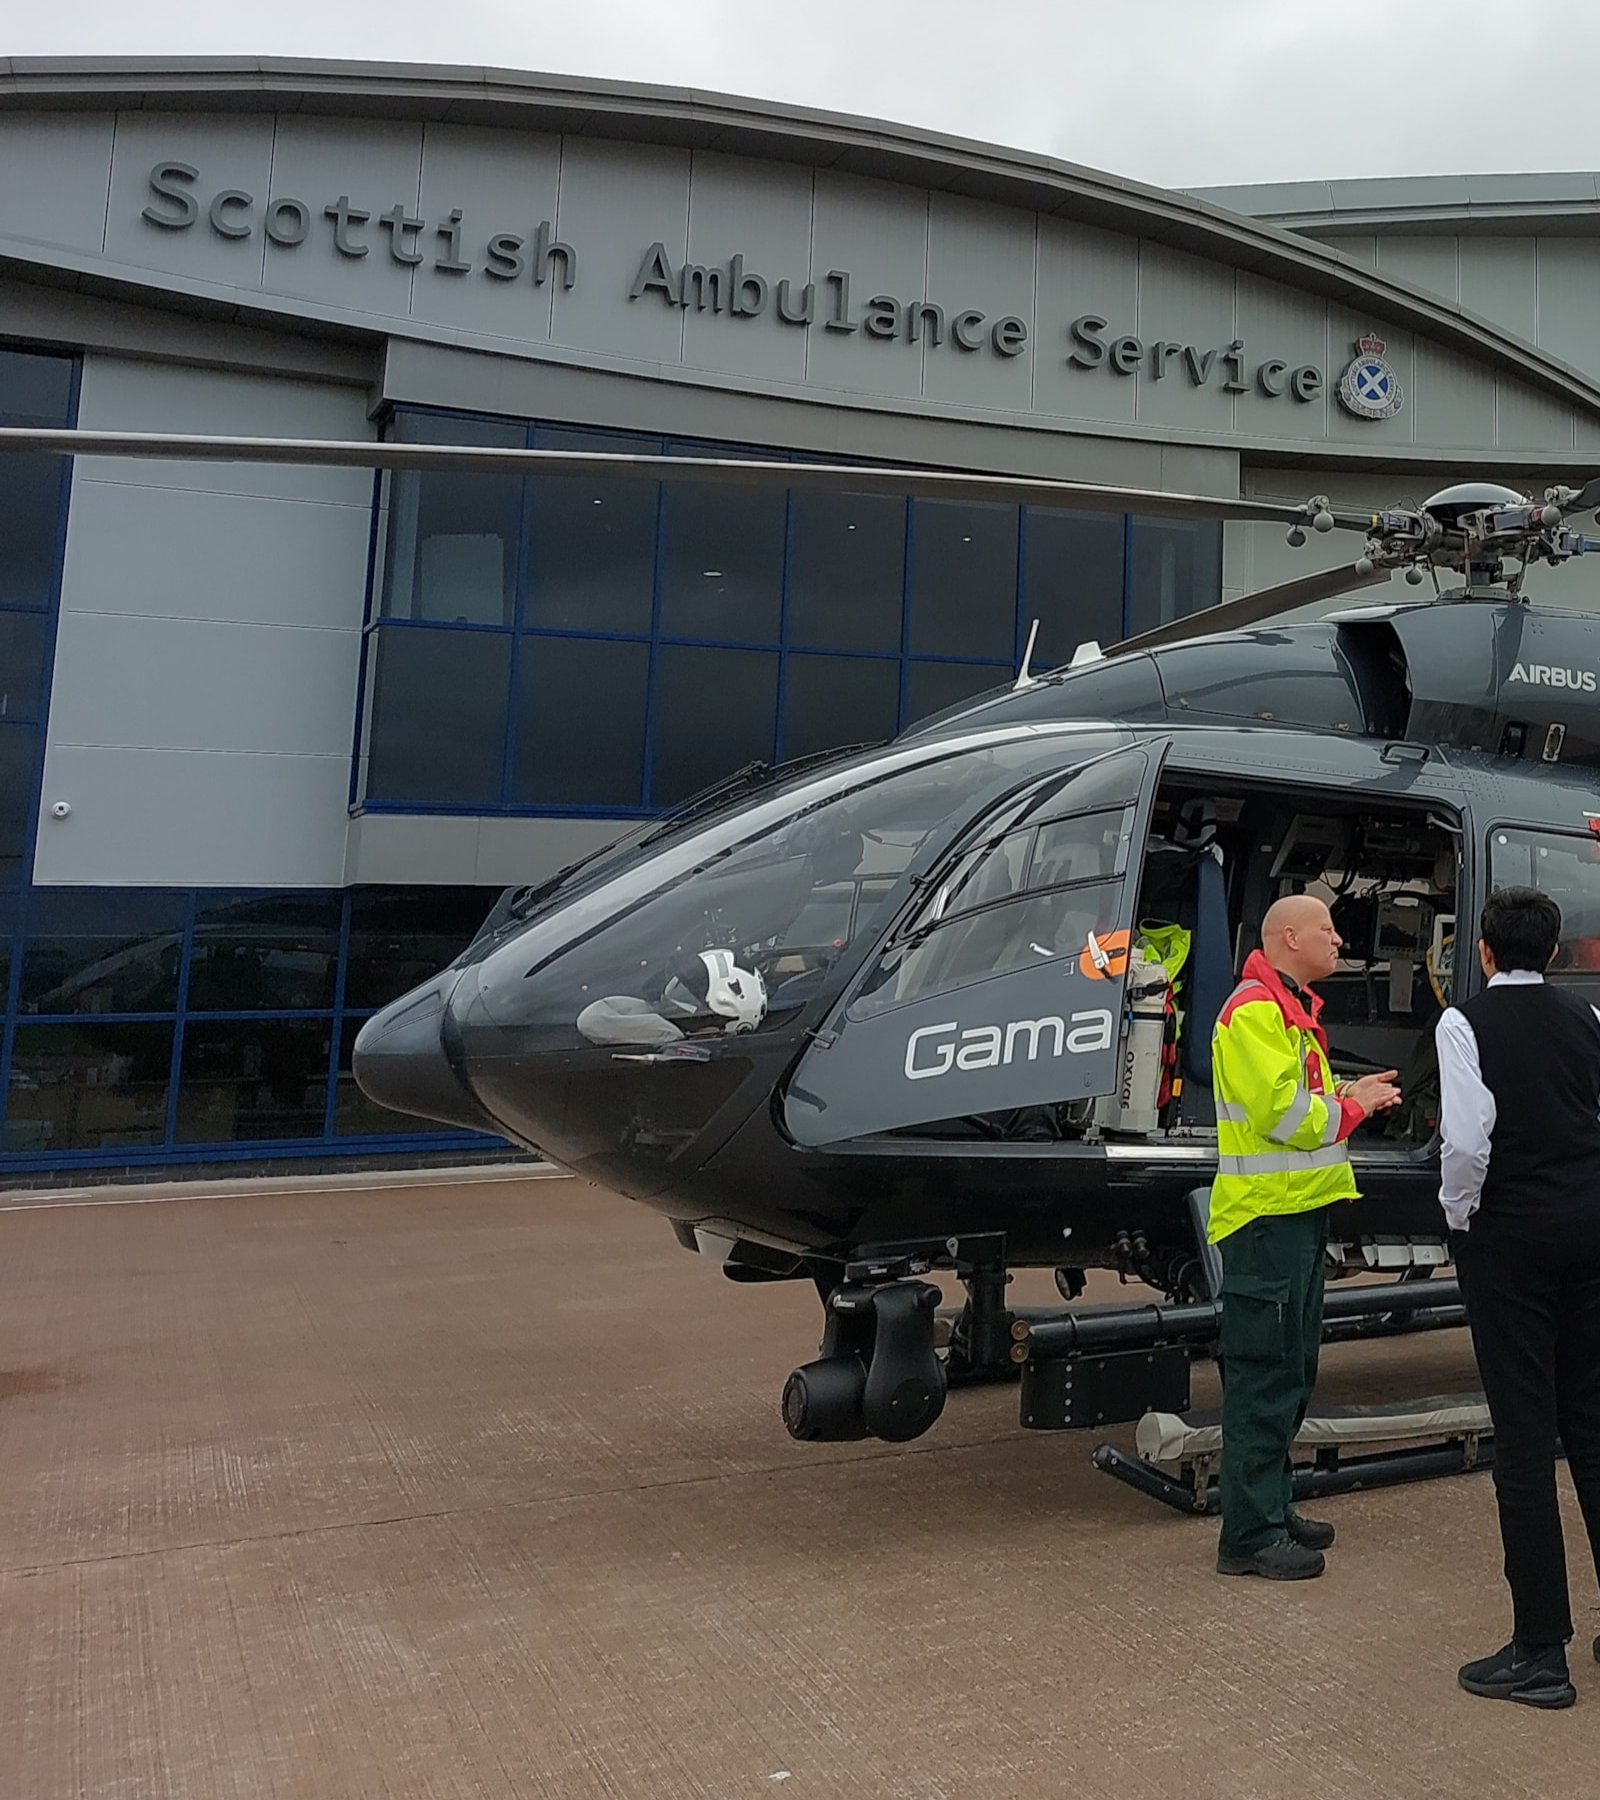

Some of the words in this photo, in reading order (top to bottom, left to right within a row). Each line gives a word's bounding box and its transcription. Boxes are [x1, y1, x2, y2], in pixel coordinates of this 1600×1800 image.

[141, 160, 578, 289] Scottish
[629, 241, 1028, 357] Ambulance
[1069, 314, 1323, 403] Service
[1508, 662, 1598, 692] AIRBUS
[905, 1008, 1113, 1080] Gama
